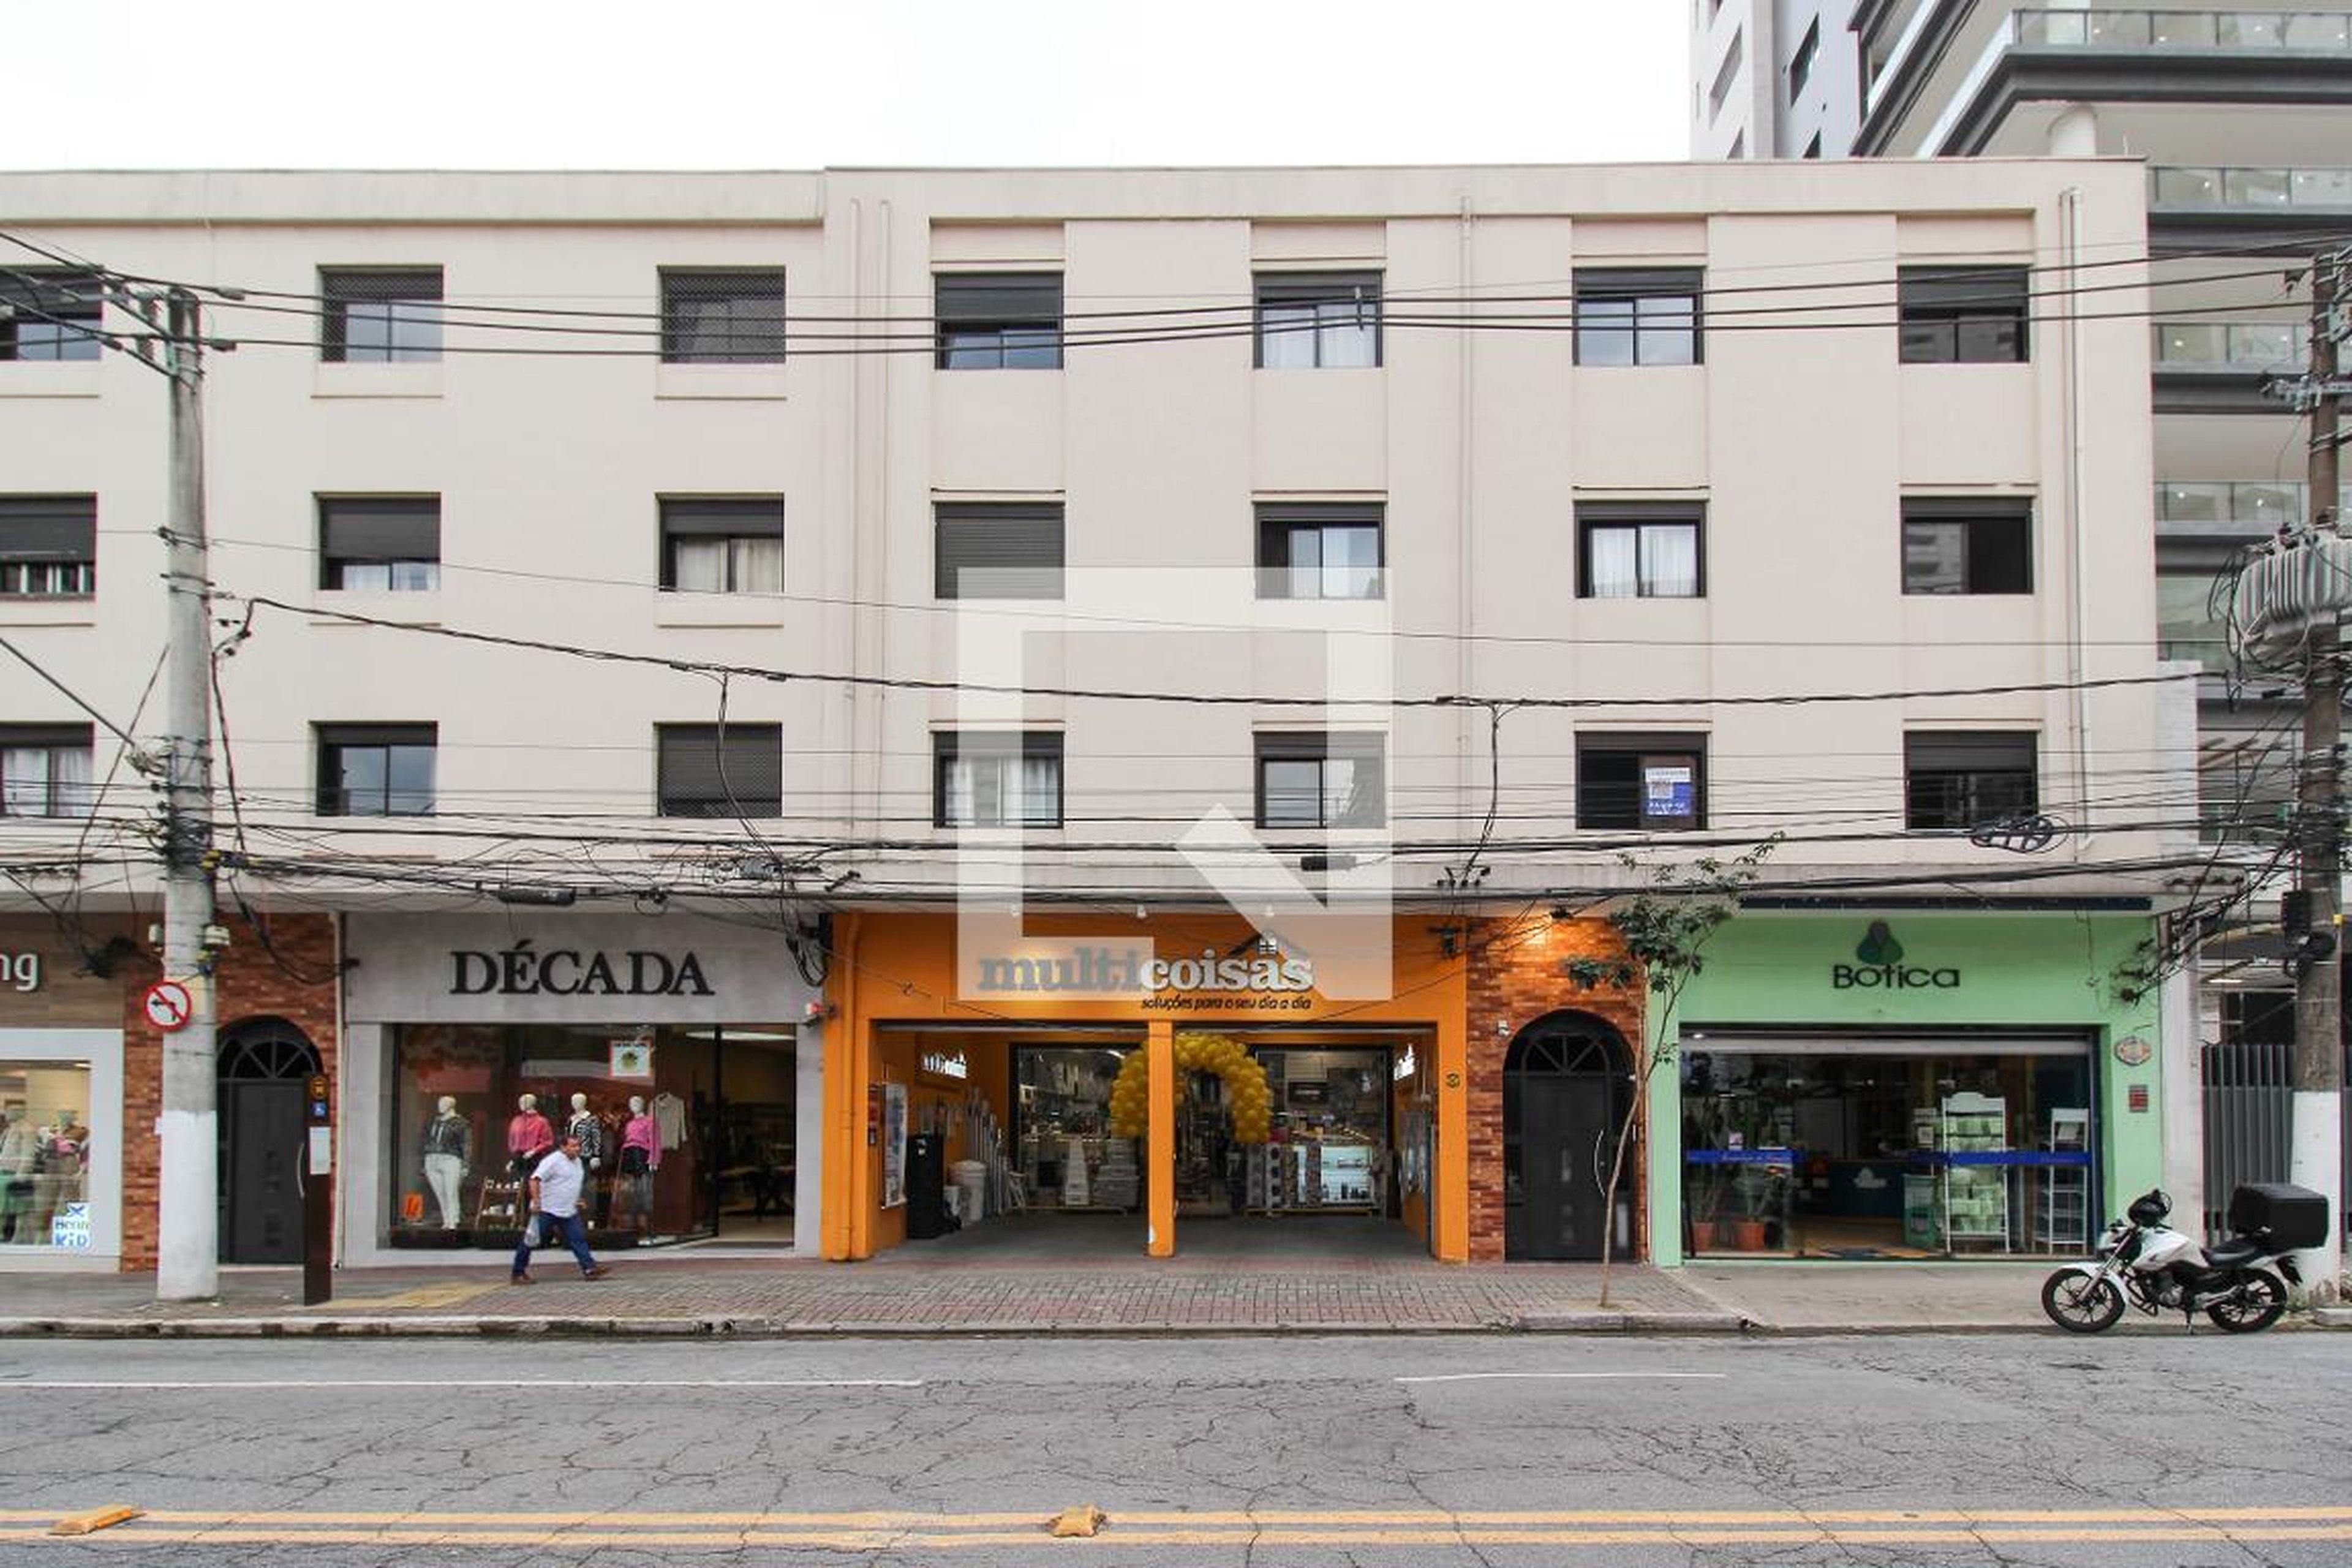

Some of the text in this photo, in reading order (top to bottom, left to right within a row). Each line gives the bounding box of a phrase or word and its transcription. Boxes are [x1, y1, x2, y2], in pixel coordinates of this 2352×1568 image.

[450, 939, 715, 995] DÉCADA
[1833, 963, 1960, 989] Botica
[1142, 993, 1312, 1011] soluções para o seu dia a dia
